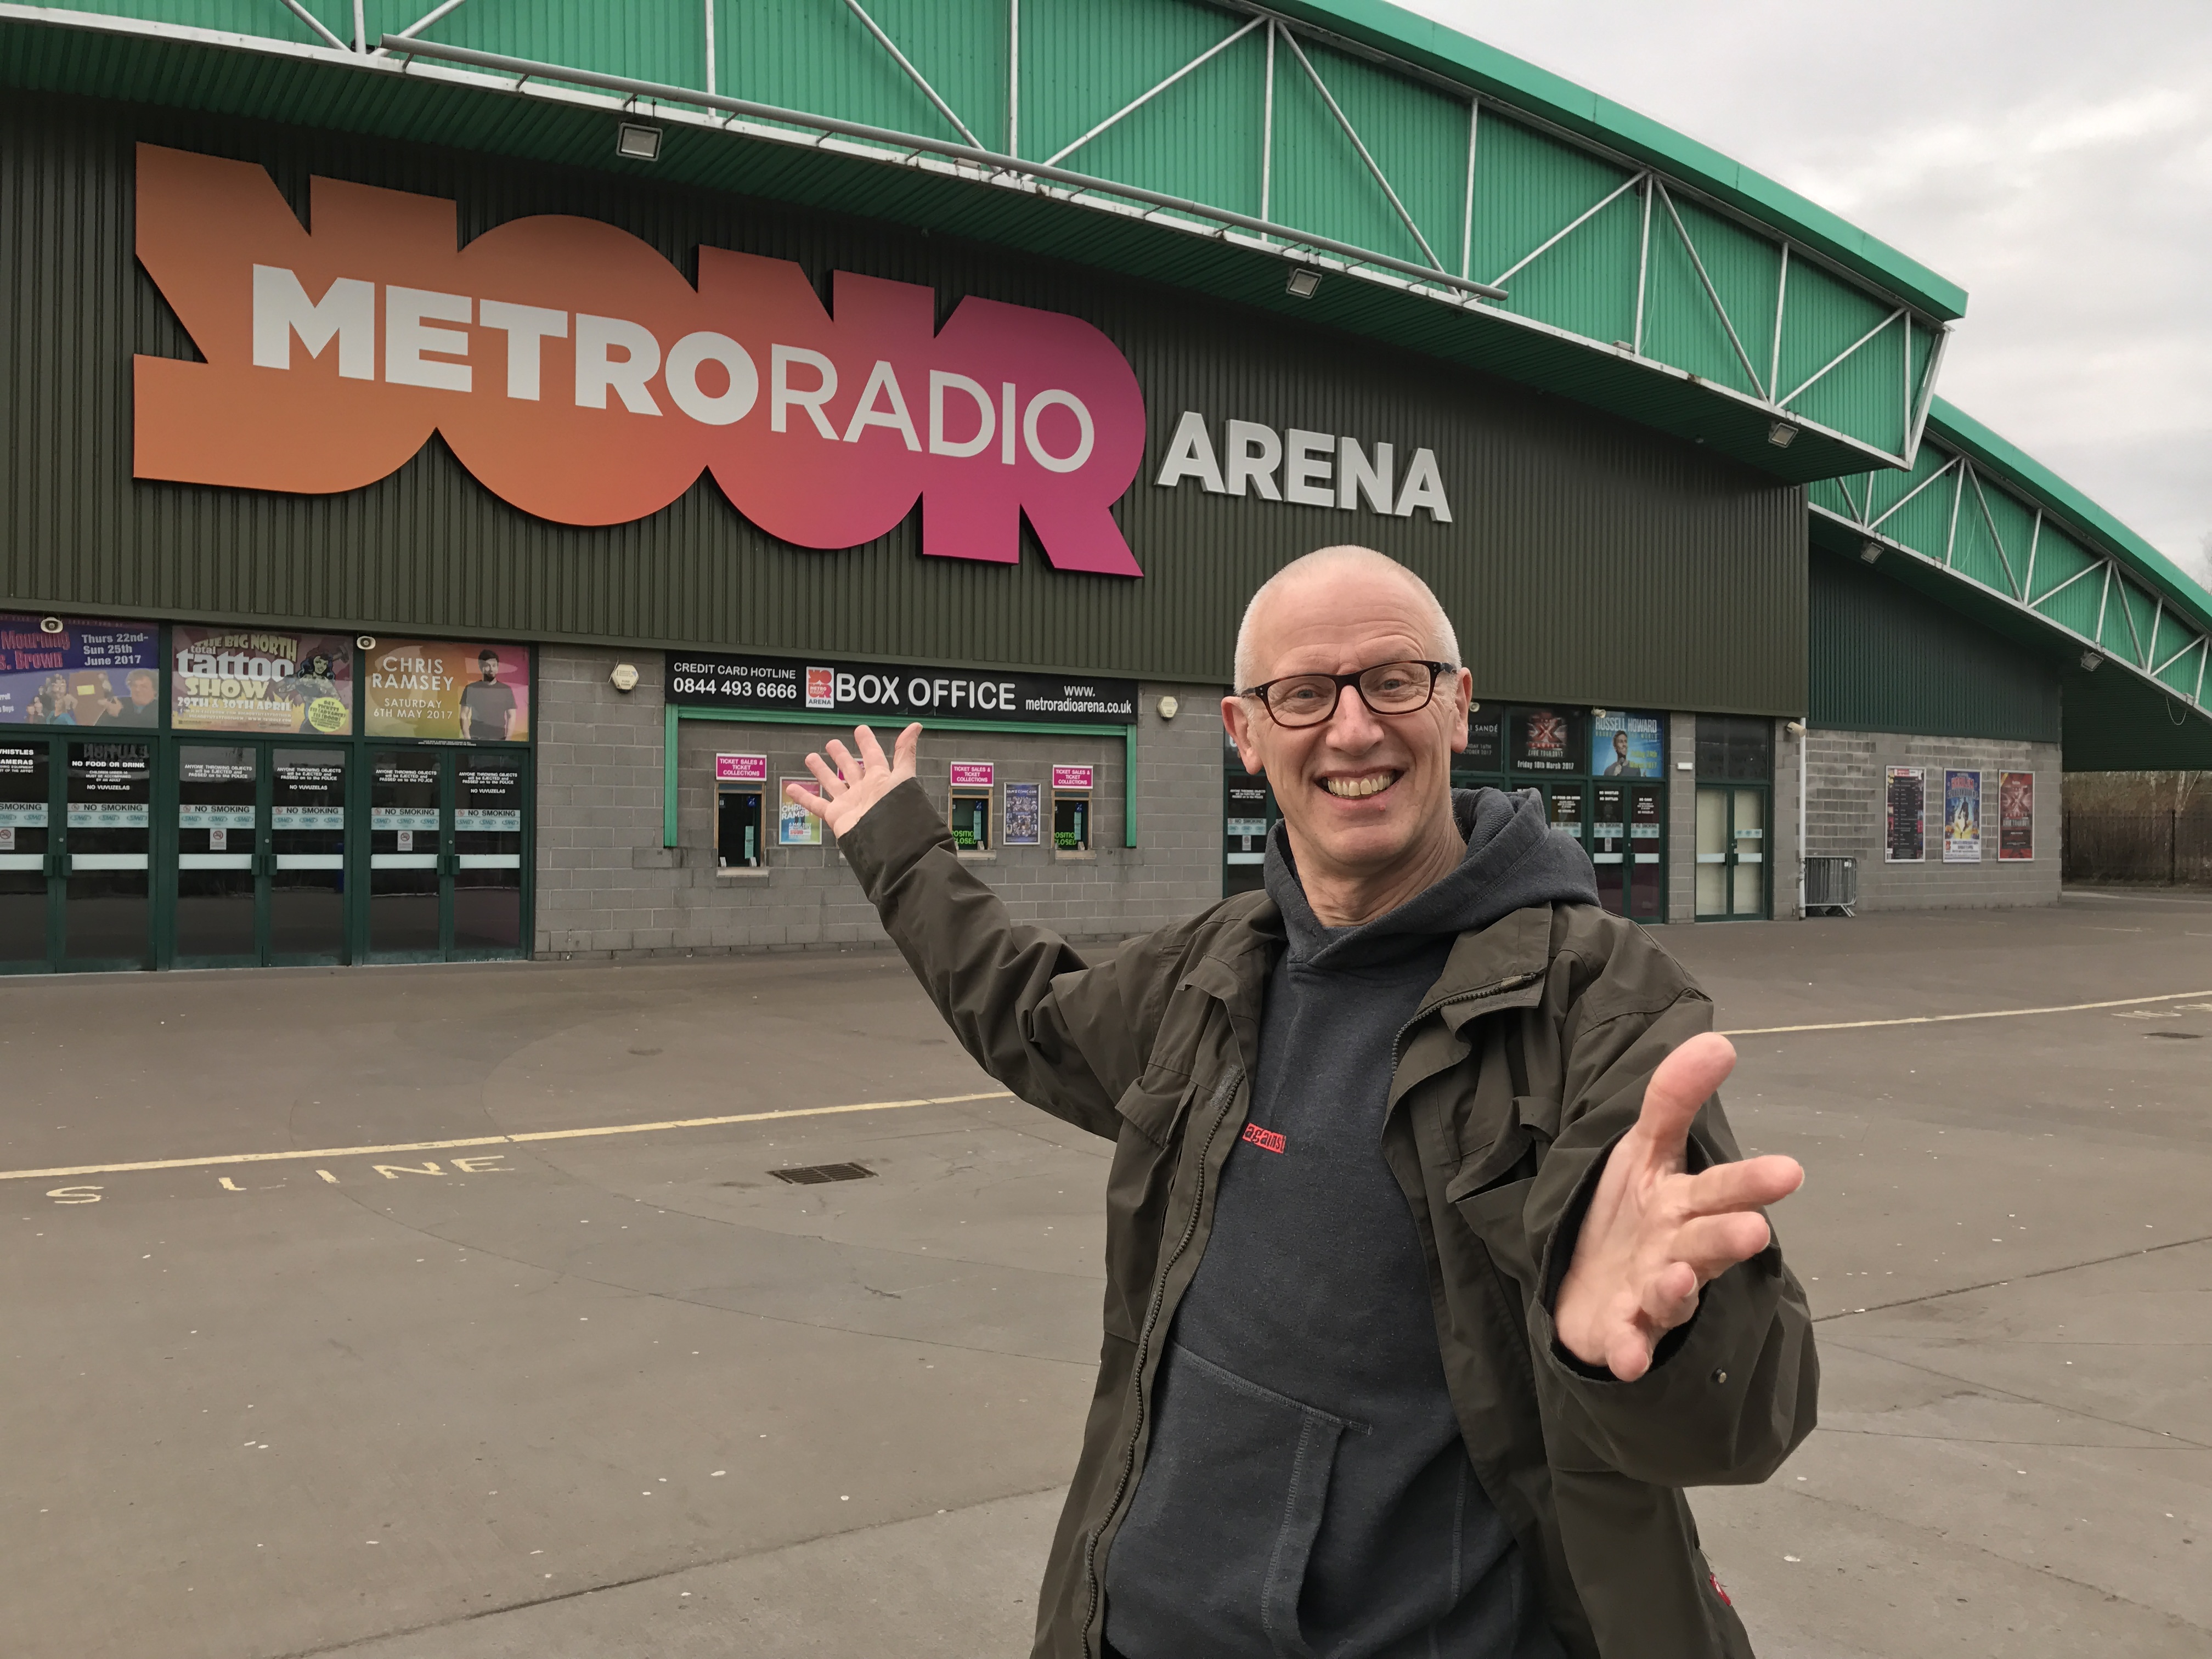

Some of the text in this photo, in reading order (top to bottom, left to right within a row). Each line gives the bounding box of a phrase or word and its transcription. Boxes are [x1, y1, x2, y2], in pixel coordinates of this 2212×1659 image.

[1154, 411, 1453, 523] ARENA
[1, 630, 70, 650] Mourning
[82, 633, 149, 643] Thurs 22nd-
[83, 645, 132, 654] Sun 25th
[191, 645, 216, 654] total
[224, 635, 249, 647] BIG
[251, 634, 297, 662] NORTH
[15, 650, 63, 669] Brown
[84, 655, 141, 666] June 2017
[176, 648, 294, 682] tattoo
[383, 656, 443, 674] CHRIS
[674, 662, 796, 680] CREDIT CARD HOTLINE
[185, 676, 269, 699] SHOW
[372, 673, 454, 691] RAMSEY
[673, 677, 797, 699] 0844 493 6666
[836, 673, 1016, 710] BOX OFFICE
[1064, 685, 1096, 697] www.
[178, 697, 292, 712] 29TH & 30TH APRIL
[385, 698, 442, 709] SATURDAY
[1026, 697, 1132, 714] metroradioarena.co.uk
[374, 708, 453, 719] 6TH MAY 2017
[1475, 724, 1498, 732] SANDÉ
[1595, 716, 1657, 733] RUSSELL HOWARD
[1517, 760, 1532, 769] Friday
[1244, 1126, 1286, 1152] against
